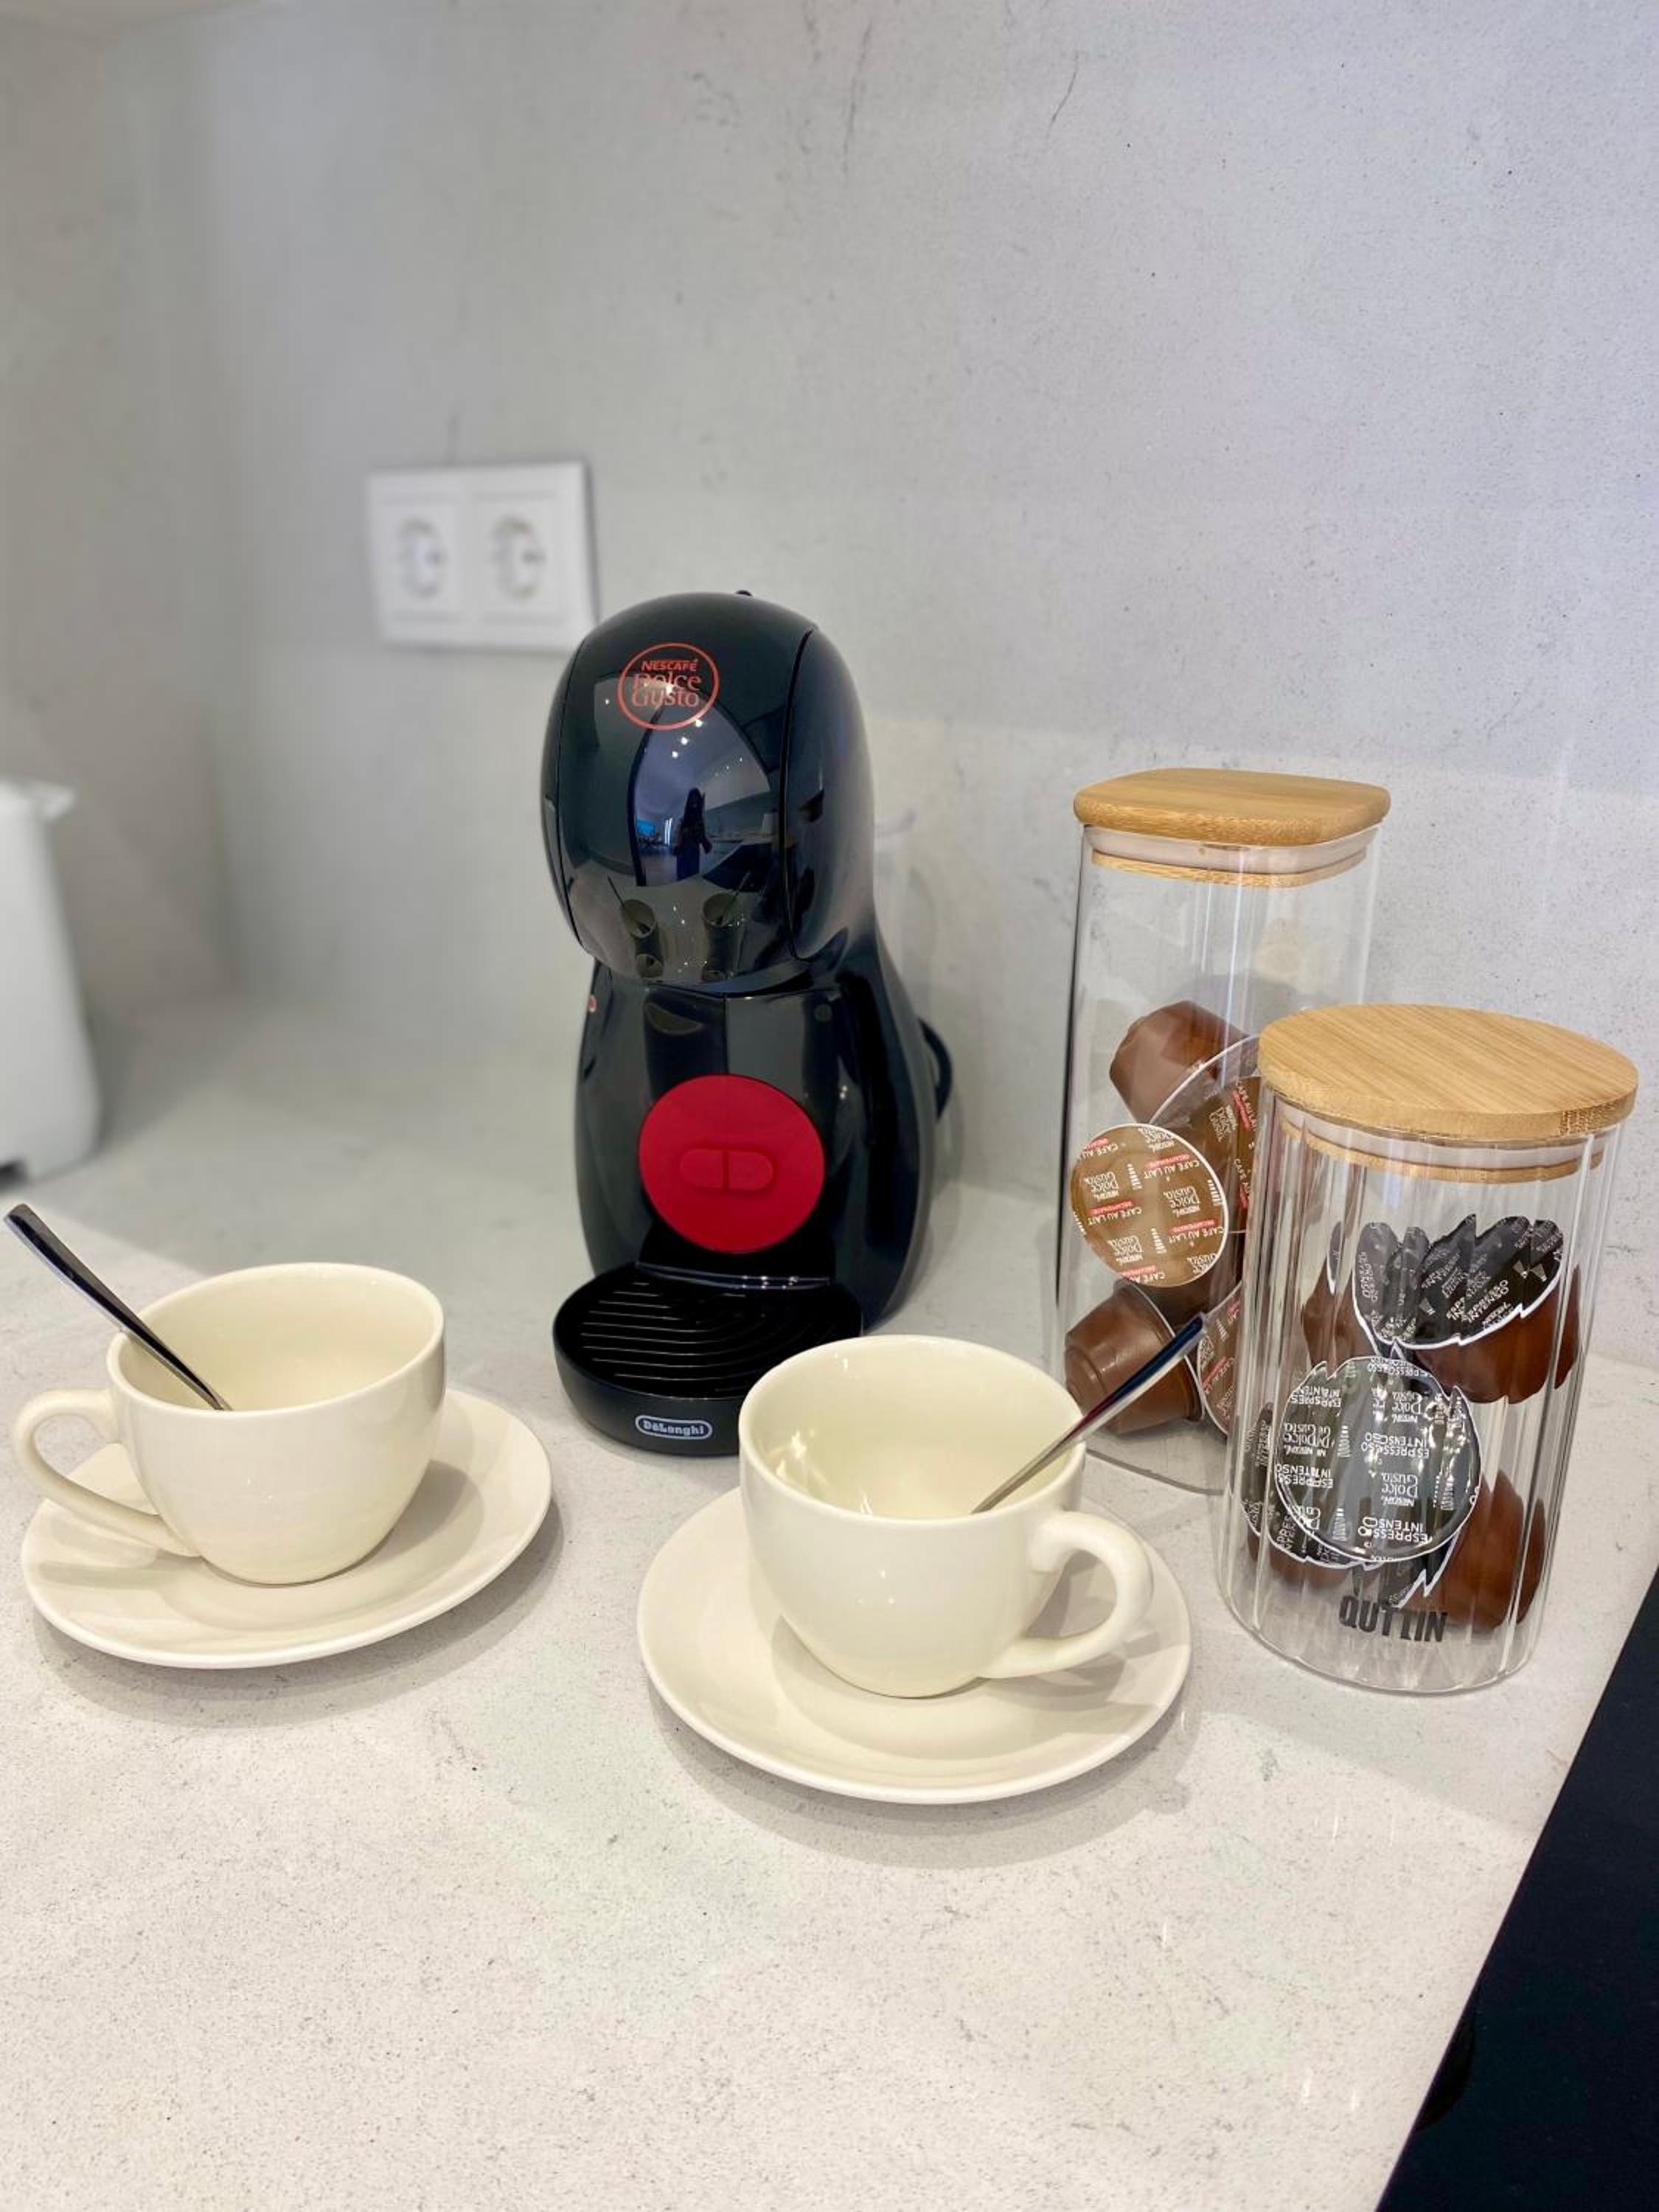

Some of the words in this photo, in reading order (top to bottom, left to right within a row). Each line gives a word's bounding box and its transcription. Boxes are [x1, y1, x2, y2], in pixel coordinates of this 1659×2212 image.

[641, 658, 698, 672] NESCAFÉ
[1164, 1165, 1176, 1174] AU
[1107, 1211, 1119, 1221] AU
[1188, 1230, 1200, 1239] AU
[1381, 1472, 1418, 1486] Gusto
[1382, 1484, 1418, 1498] Dolce
